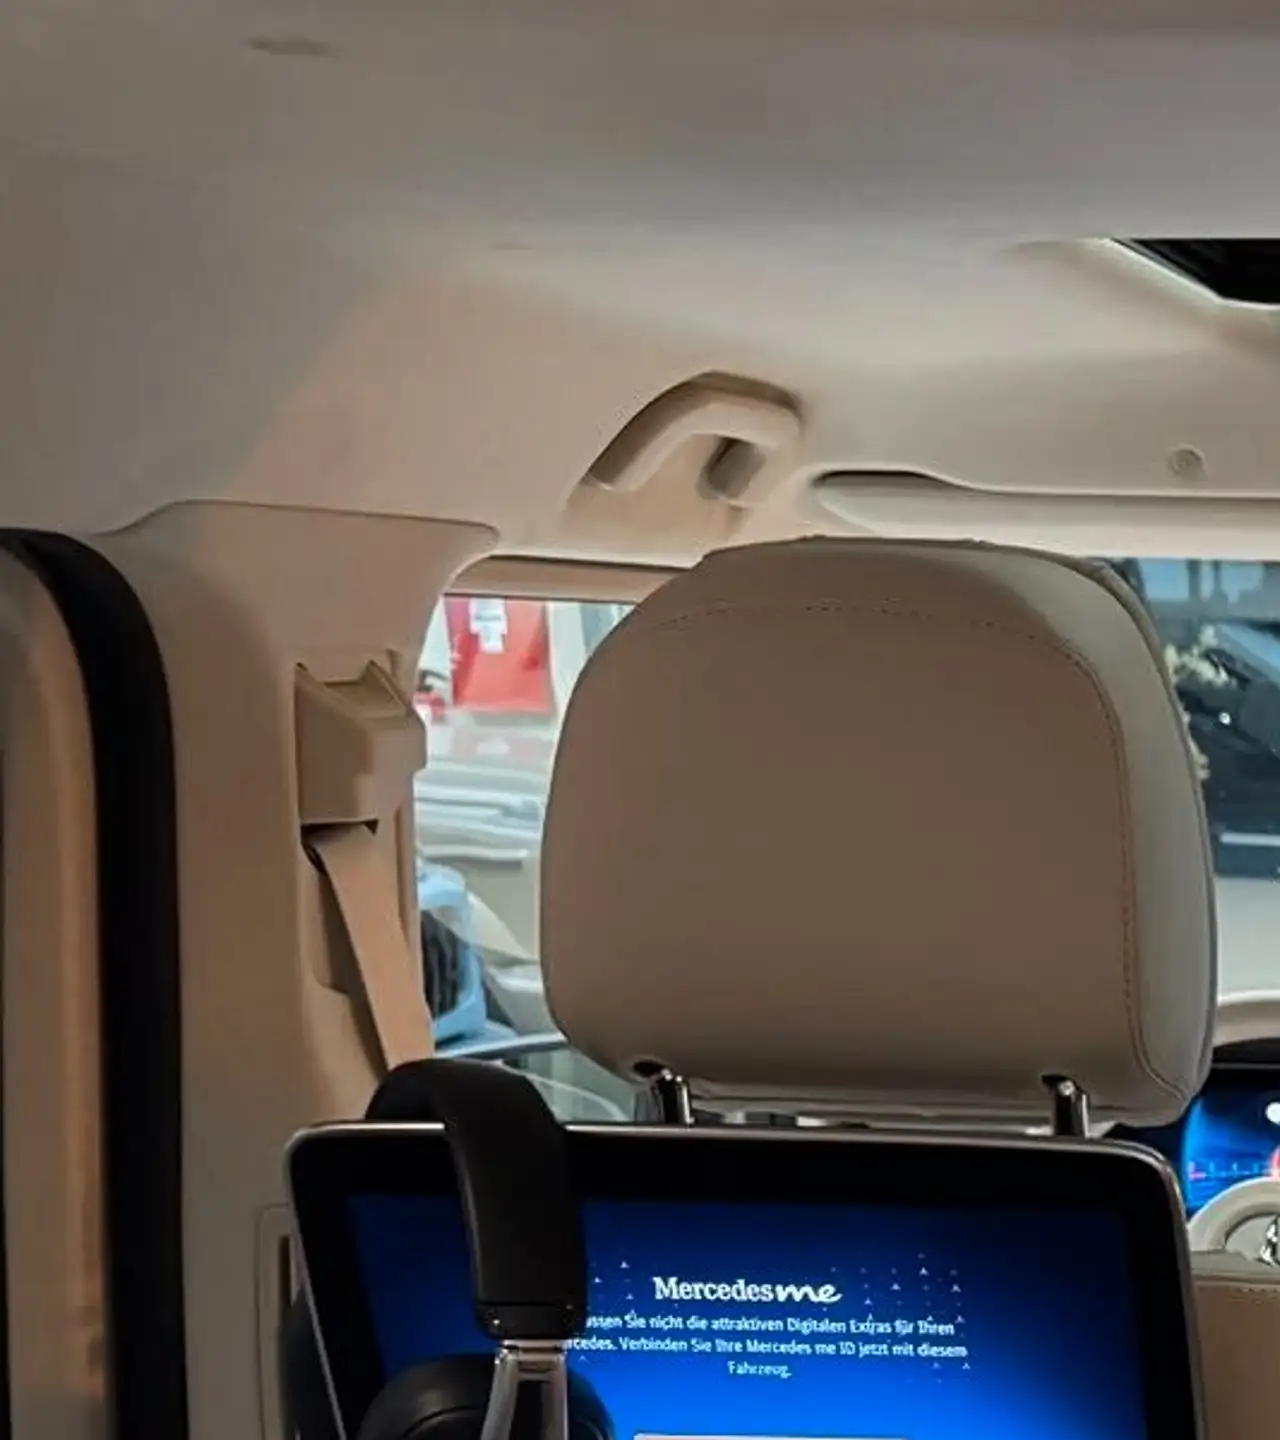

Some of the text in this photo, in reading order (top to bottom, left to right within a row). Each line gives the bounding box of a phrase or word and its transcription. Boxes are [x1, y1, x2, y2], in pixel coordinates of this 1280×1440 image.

[624, 1314, 647, 1329] Sie
[649, 1314, 684, 1331] nicht
[686, 1314, 708, 1330] die
[710, 1315, 784, 1332] attraktiven
[786, 1317, 846, 1335] Digitalen
[849, 1318, 893, 1334] Extras
[894, 1319, 915, 1336] für
[917, 1320, 955, 1336] Ihren
[618, 1336, 687, 1351] Verbinden
[691, 1337, 712, 1352] Sie
[715, 1338, 743, 1352] Ihre
[746, 1339, 812, 1355] Mercedes
[815, 1342, 837, 1355] me
[839, 1341, 854, 1355] ID
[857, 1341, 890, 1358] jetzt
[892, 1342, 915, 1356] mit
[917, 1342, 968, 1357] diesem
